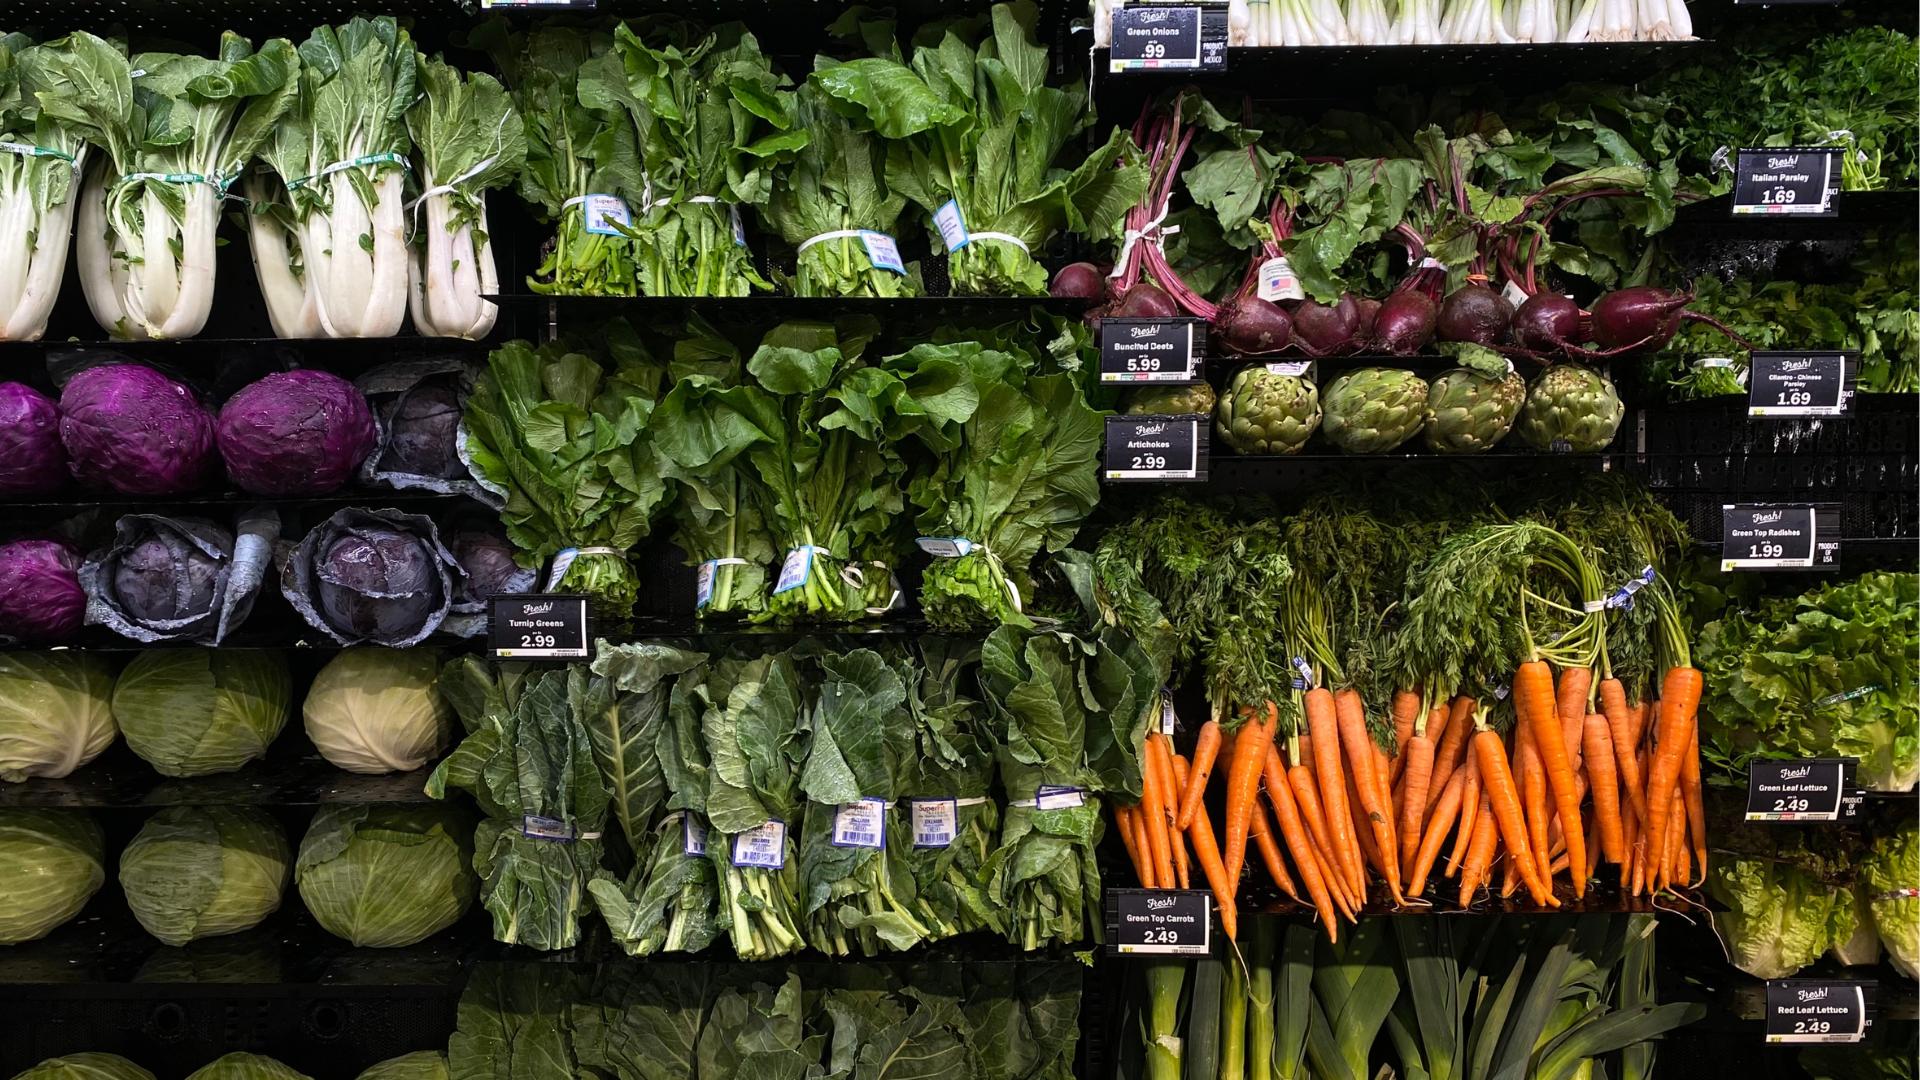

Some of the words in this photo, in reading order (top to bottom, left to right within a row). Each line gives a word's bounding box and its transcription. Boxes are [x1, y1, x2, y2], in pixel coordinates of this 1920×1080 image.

[1140, 9, 1169, 23] Fresh!
[1141, 44, 1165, 58] .99
[1768, 155, 1798, 169] Fresh!
[1752, 174, 1778, 182] Italian
[1779, 174, 1809, 182] Parsley
[1762, 190, 1796, 204] 1.69
[1131, 324, 1160, 339] Fresh!
[1127, 358, 1160, 371] 5.99
[1782, 358, 1812, 372] Fresh!
[1777, 392, 1811, 405] 1.69
[1136, 423, 1165, 436] Fresh!
[1132, 456, 1166, 469] 2.99
[1752, 510, 1782, 524] Fresh!
[1749, 544, 1783, 558] 1.99
[523, 602, 553, 616] Fresh!
[509, 620, 534, 628] Turnip
[521, 635, 555, 647] 2.99
[1780, 766, 1810, 780] Fresh!
[1773, 799, 1809, 811] 2.49
[1147, 896, 1177, 910] Fresh!
[1126, 914, 1149, 922] Green
[1151, 914, 1165, 923] Top
[1143, 930, 1178, 943] 2.49
[1798, 987, 1828, 1002] Fresh!
[1794, 1022, 1830, 1033] 2.49
